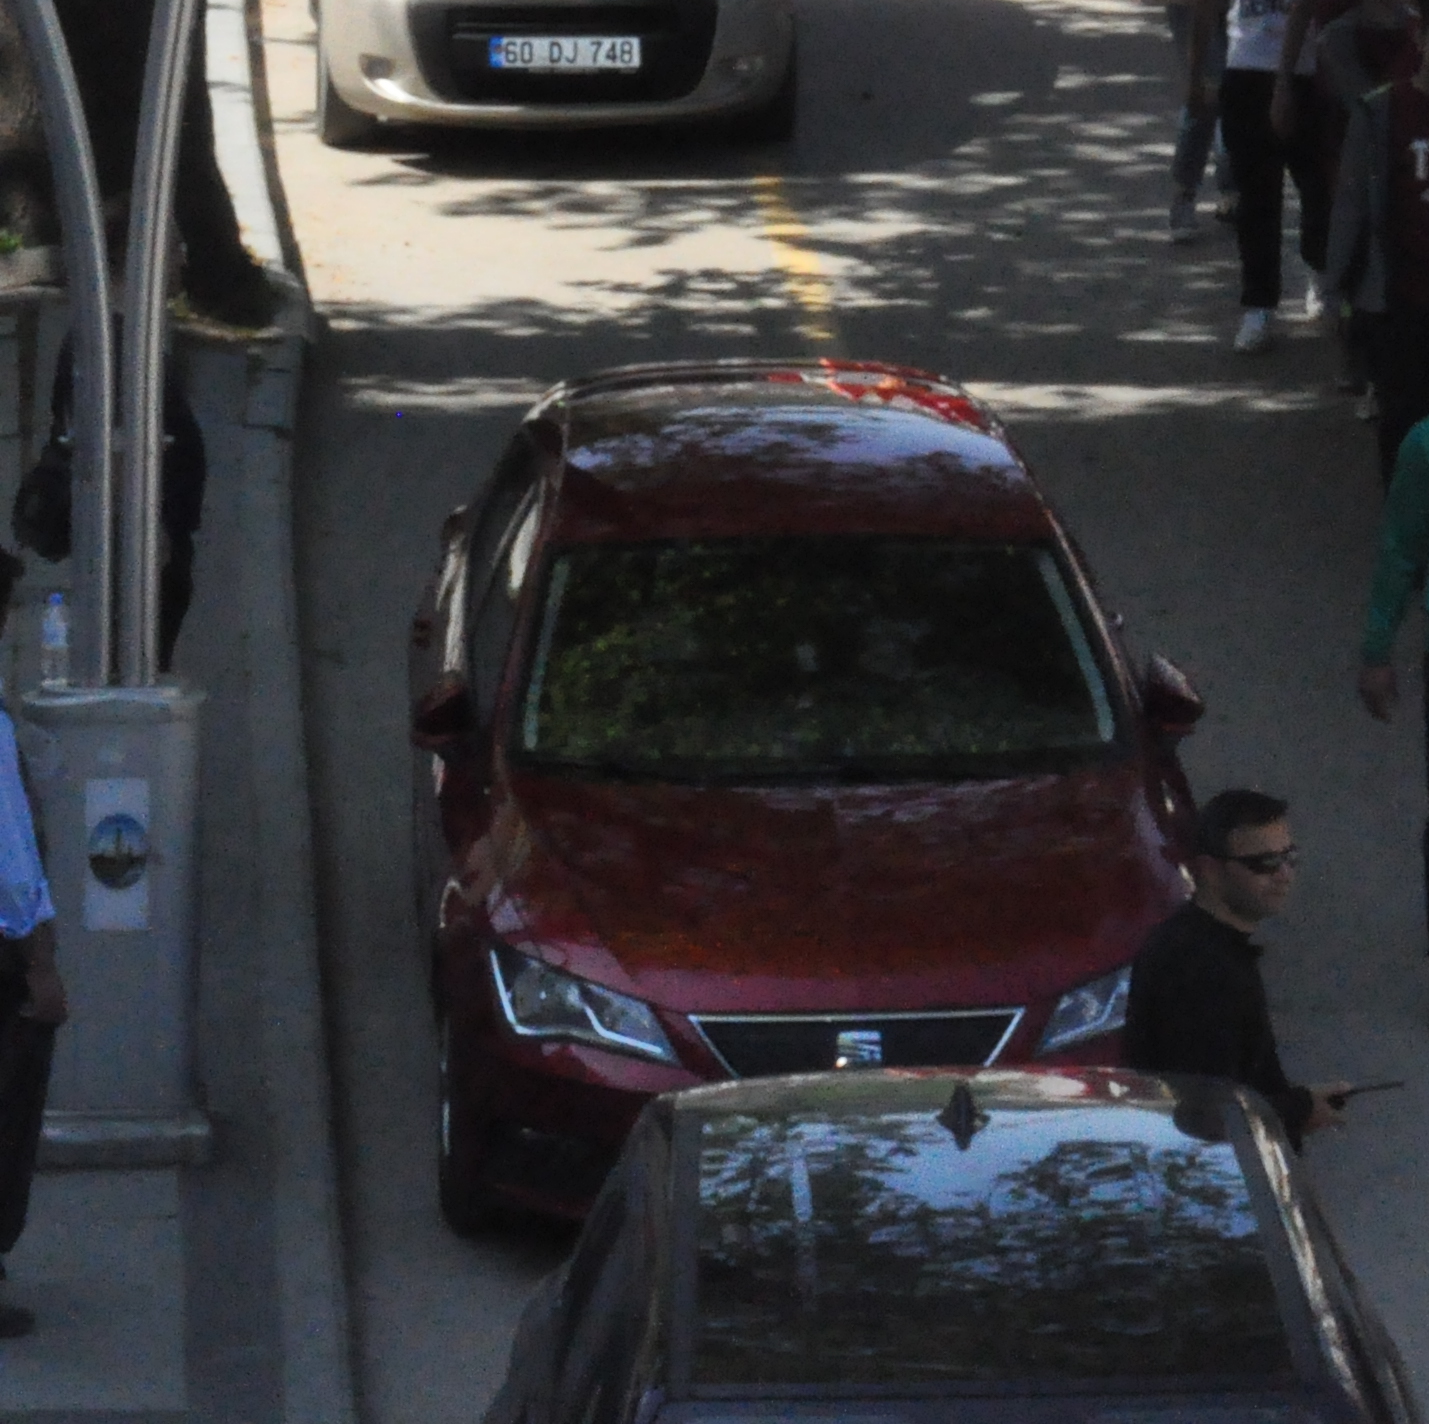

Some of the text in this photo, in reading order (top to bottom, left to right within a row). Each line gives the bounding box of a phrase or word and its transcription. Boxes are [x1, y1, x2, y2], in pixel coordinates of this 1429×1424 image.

[505, 41, 634, 64] 60 DJ 748
